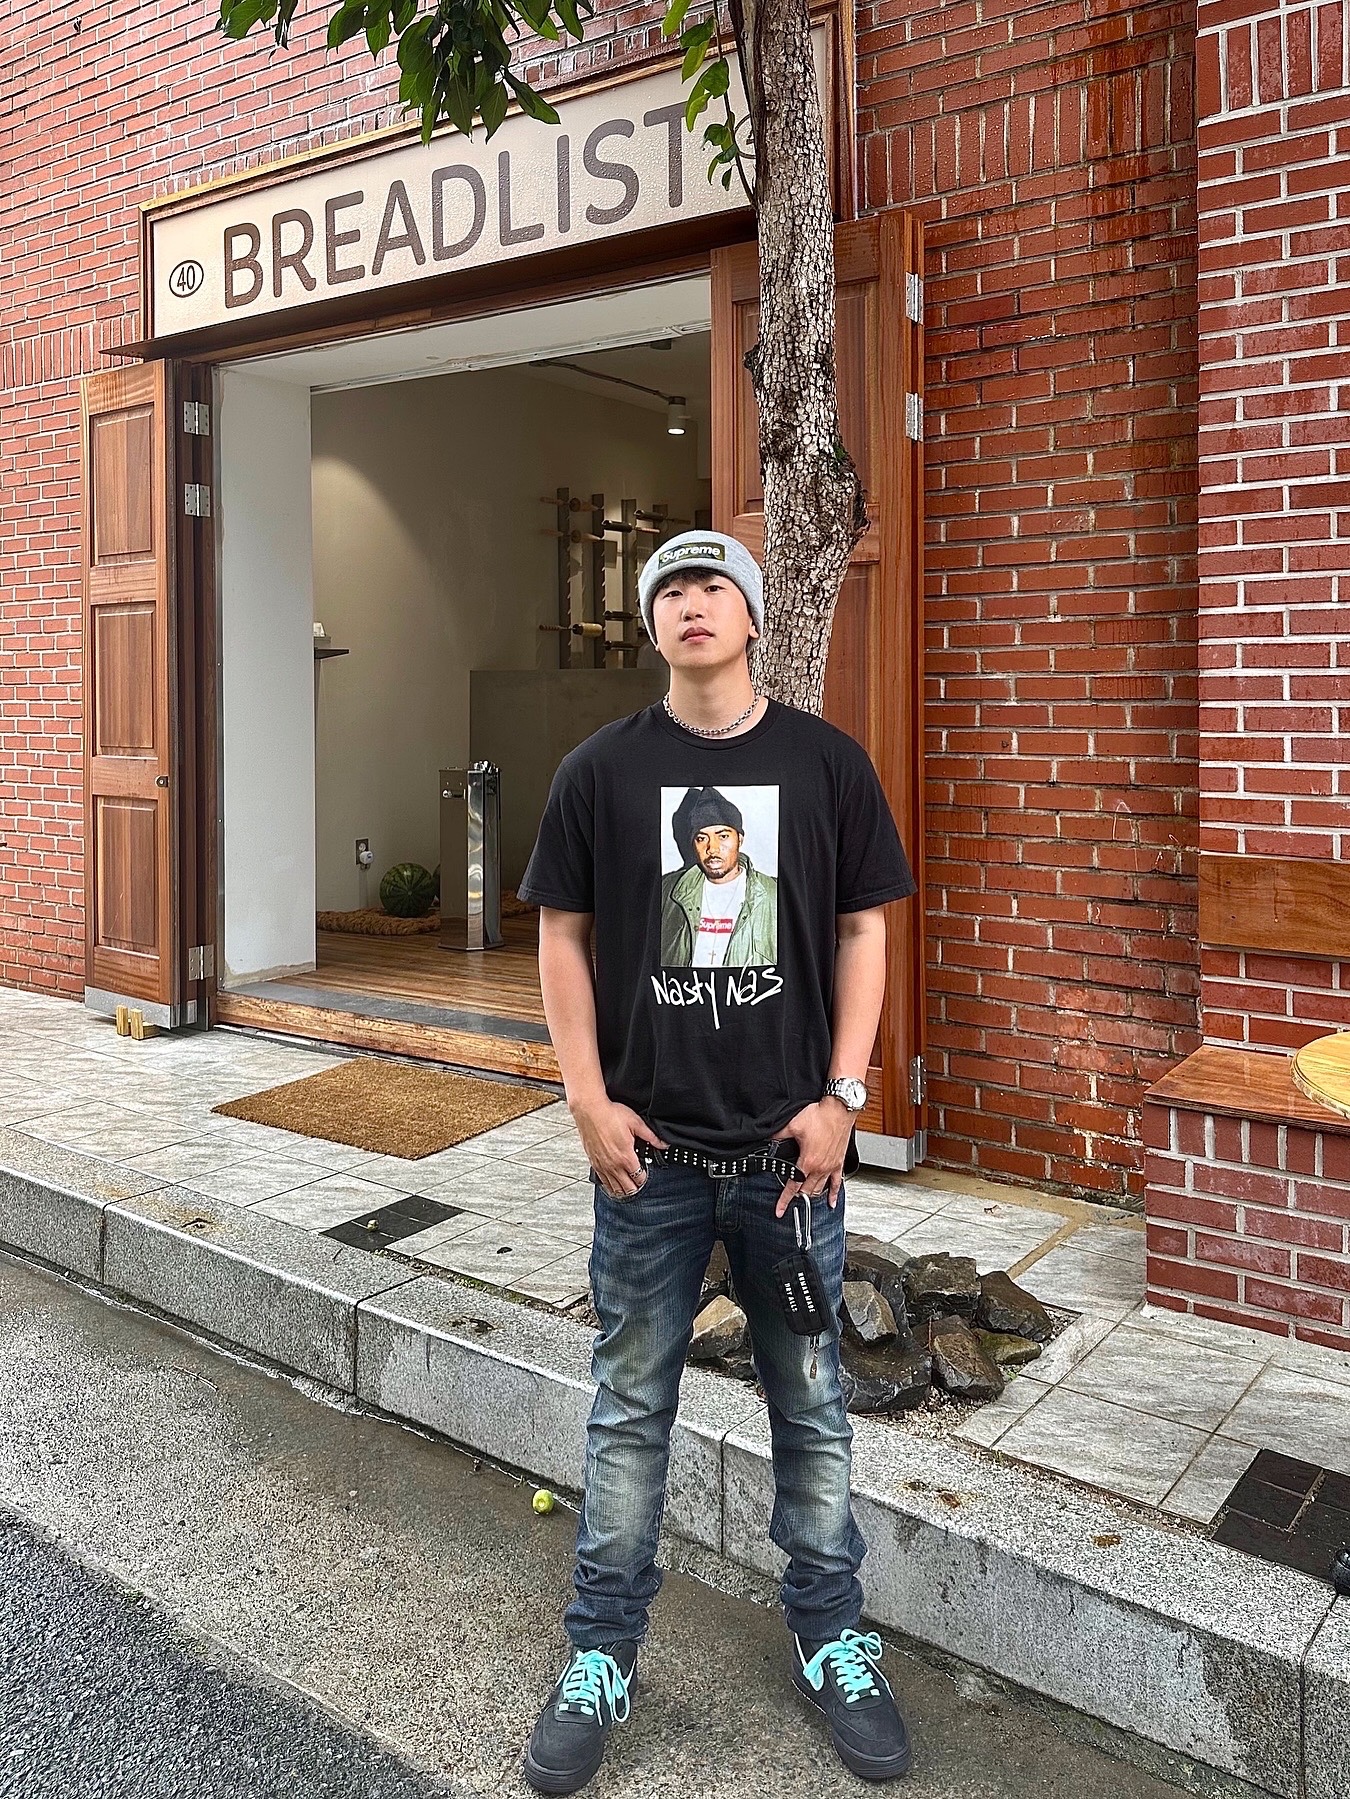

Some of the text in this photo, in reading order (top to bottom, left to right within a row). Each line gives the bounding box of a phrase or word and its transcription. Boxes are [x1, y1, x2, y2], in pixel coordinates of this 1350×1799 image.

[176, 100, 707, 308] 40 BREADLIST
[661, 545, 721, 562] Supreme
[699, 918, 732, 931] Supreme
[650, 955, 784, 1030] Nasty Nas
